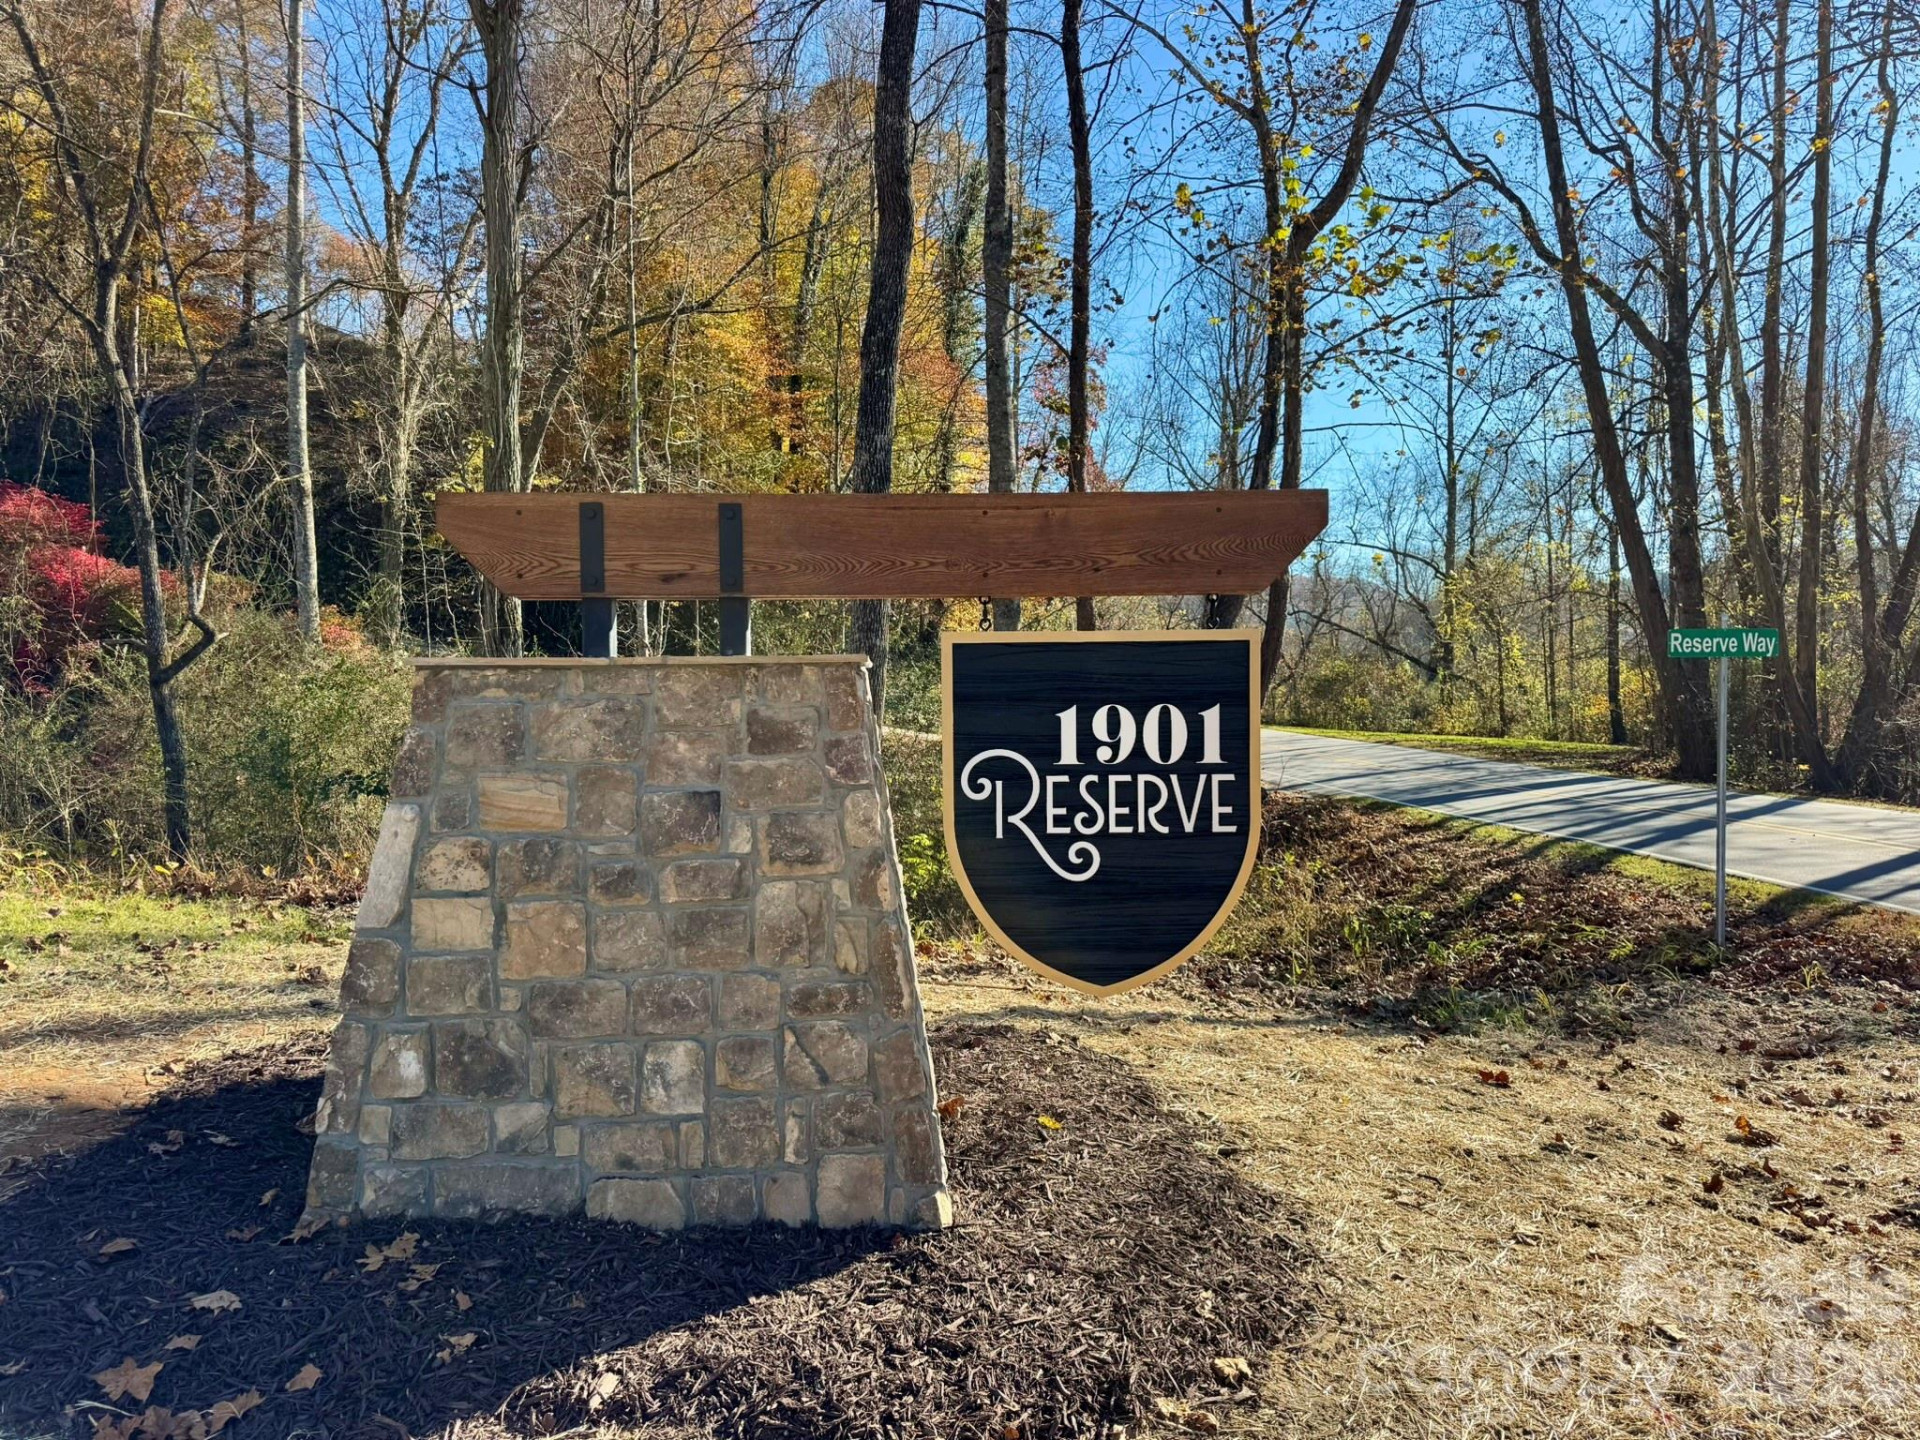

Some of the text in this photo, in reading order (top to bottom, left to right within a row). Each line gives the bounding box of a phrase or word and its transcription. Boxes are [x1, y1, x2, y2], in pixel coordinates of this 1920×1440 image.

[1670, 632, 1776, 657] Reserve Way
[1053, 703, 1228, 765] 1901
[960, 748, 1238, 882] RESERVE
